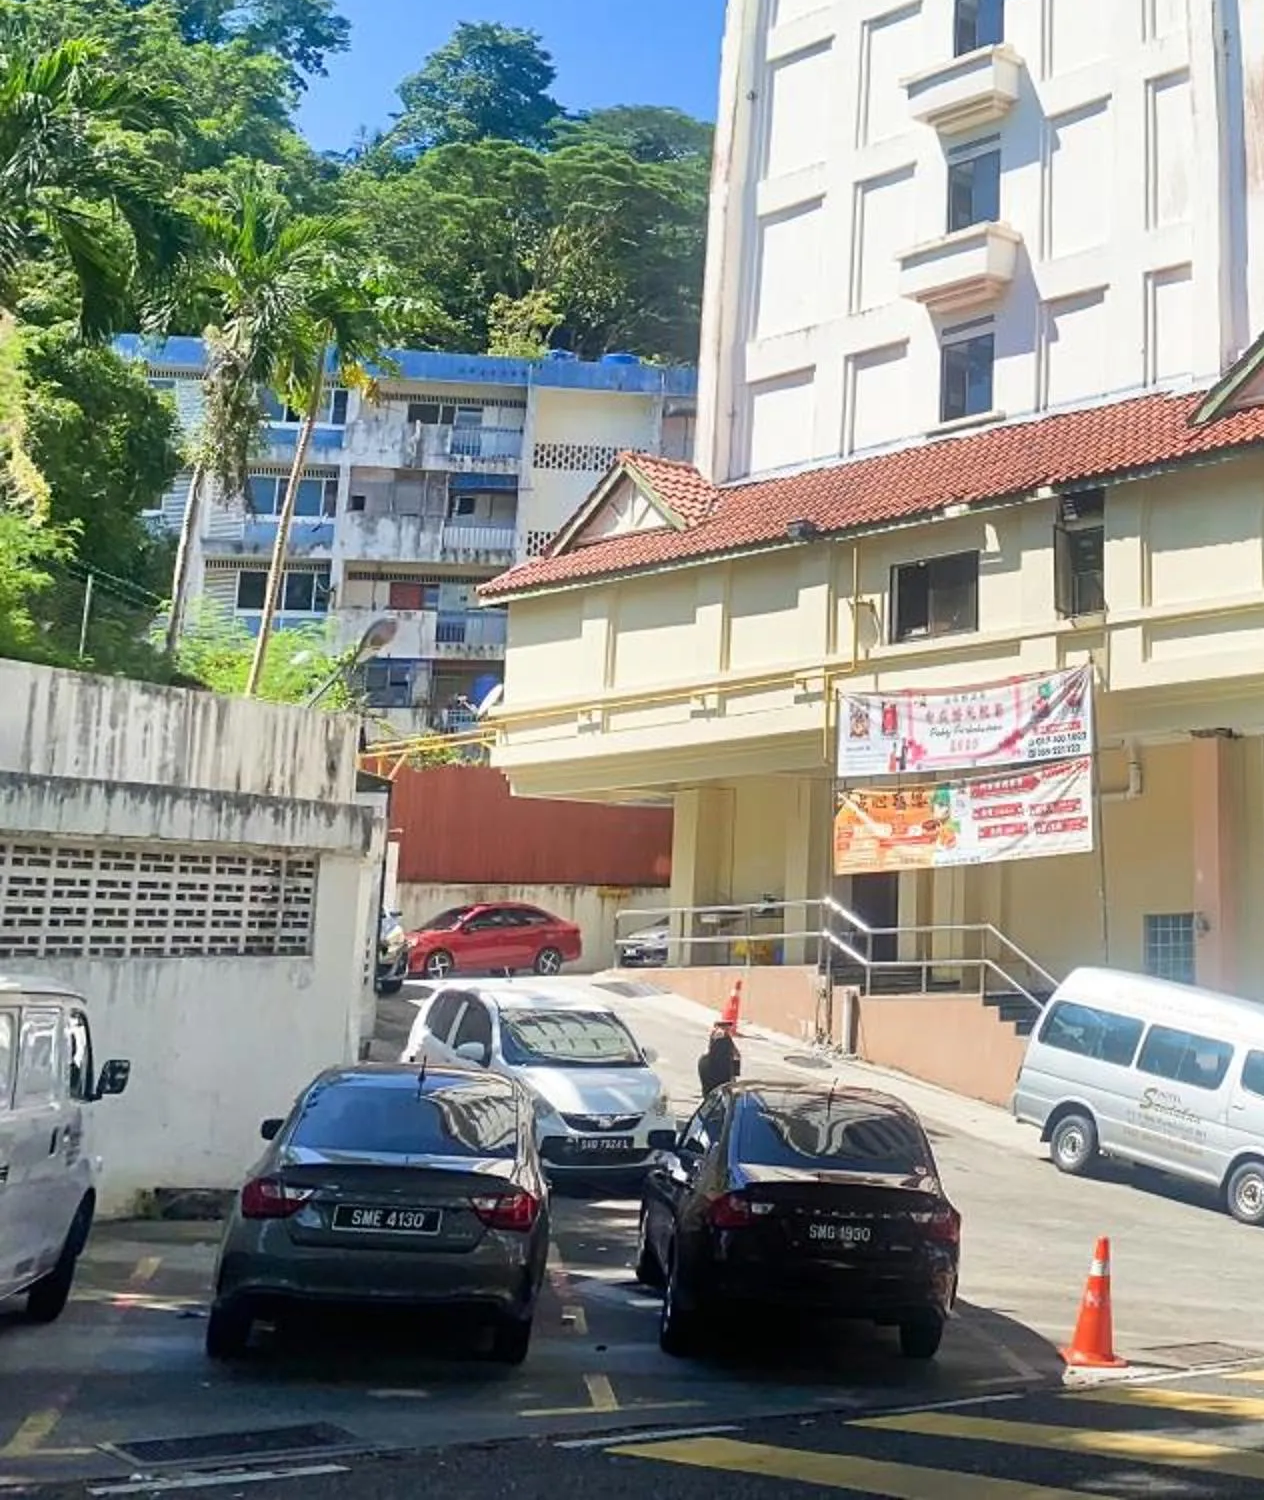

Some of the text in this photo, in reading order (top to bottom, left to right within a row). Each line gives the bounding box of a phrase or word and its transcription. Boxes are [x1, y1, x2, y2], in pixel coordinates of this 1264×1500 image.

[351, 1209, 425, 1229] SME 4130
[809, 1224, 835, 1239] SMG
